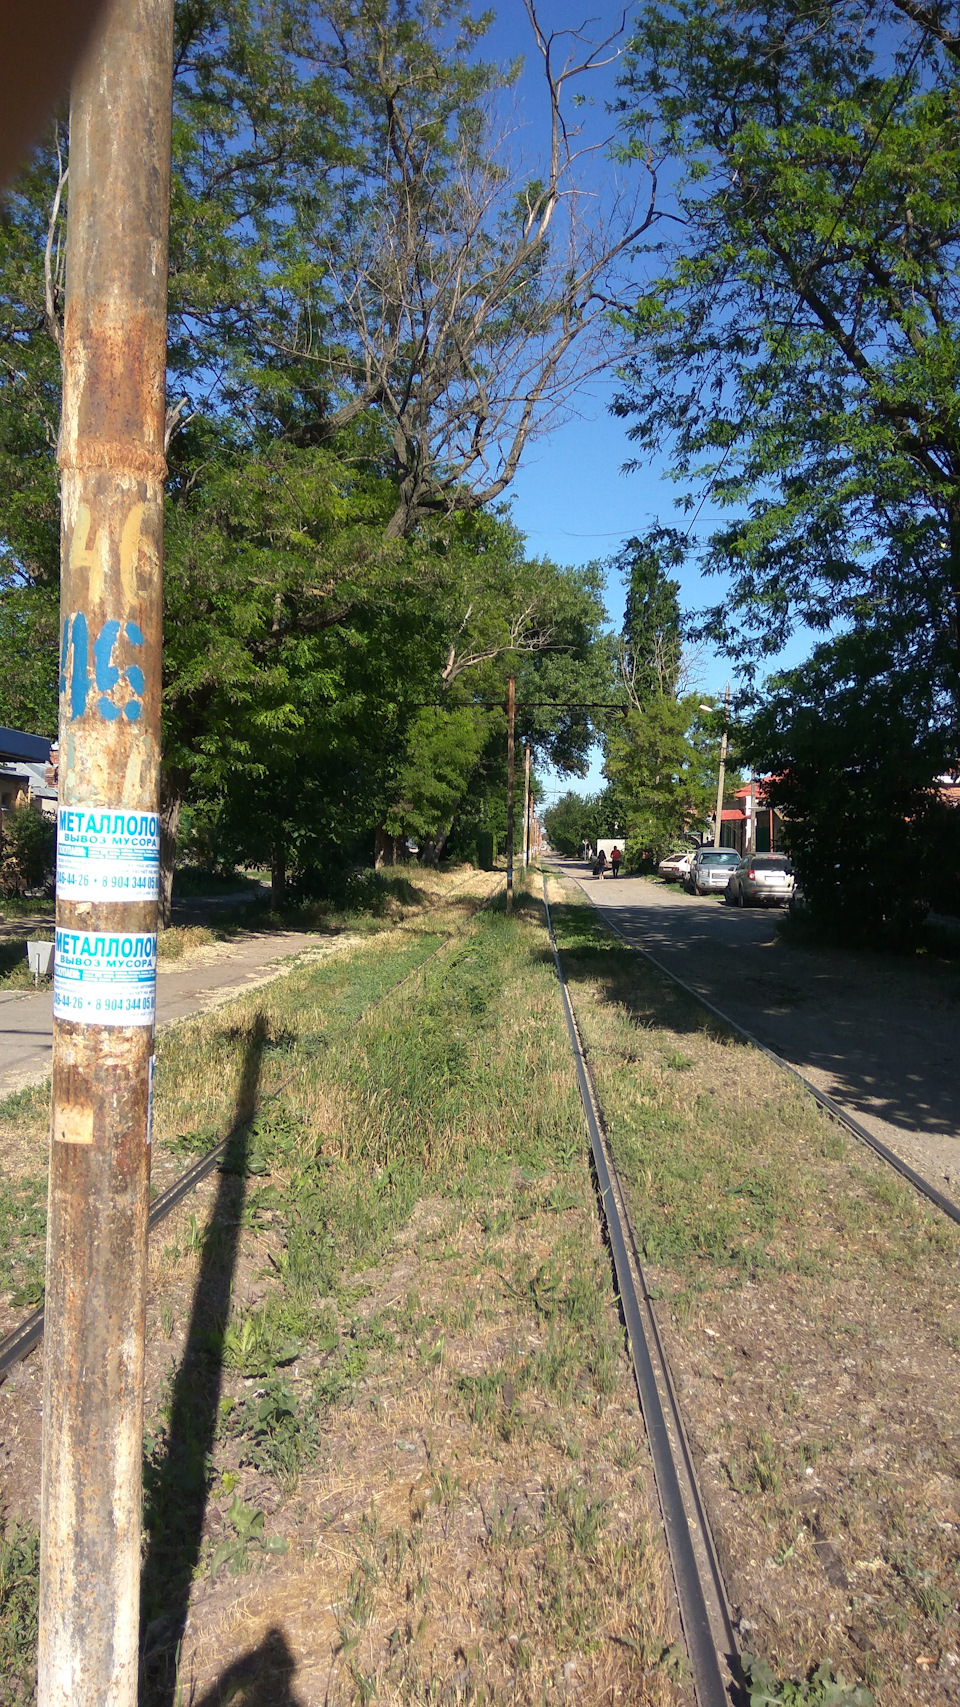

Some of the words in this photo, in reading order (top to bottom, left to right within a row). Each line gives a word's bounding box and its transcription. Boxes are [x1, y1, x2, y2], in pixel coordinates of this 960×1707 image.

[64, 833, 106, 844] ВЫВОЗ
[112, 837, 157, 847] МУСОРА
[102, 875, 108, 887] 8
[111, 876, 129, 888] 904
[132, 876, 146, 889] 344
[60, 954, 101, 967] ВЫВОЗ
[106, 958, 152, 968] МУСОРА
[95, 998, 102, 1010] 8
[104, 999, 123, 1011] 904
[125, 998, 141, 1011] 344
